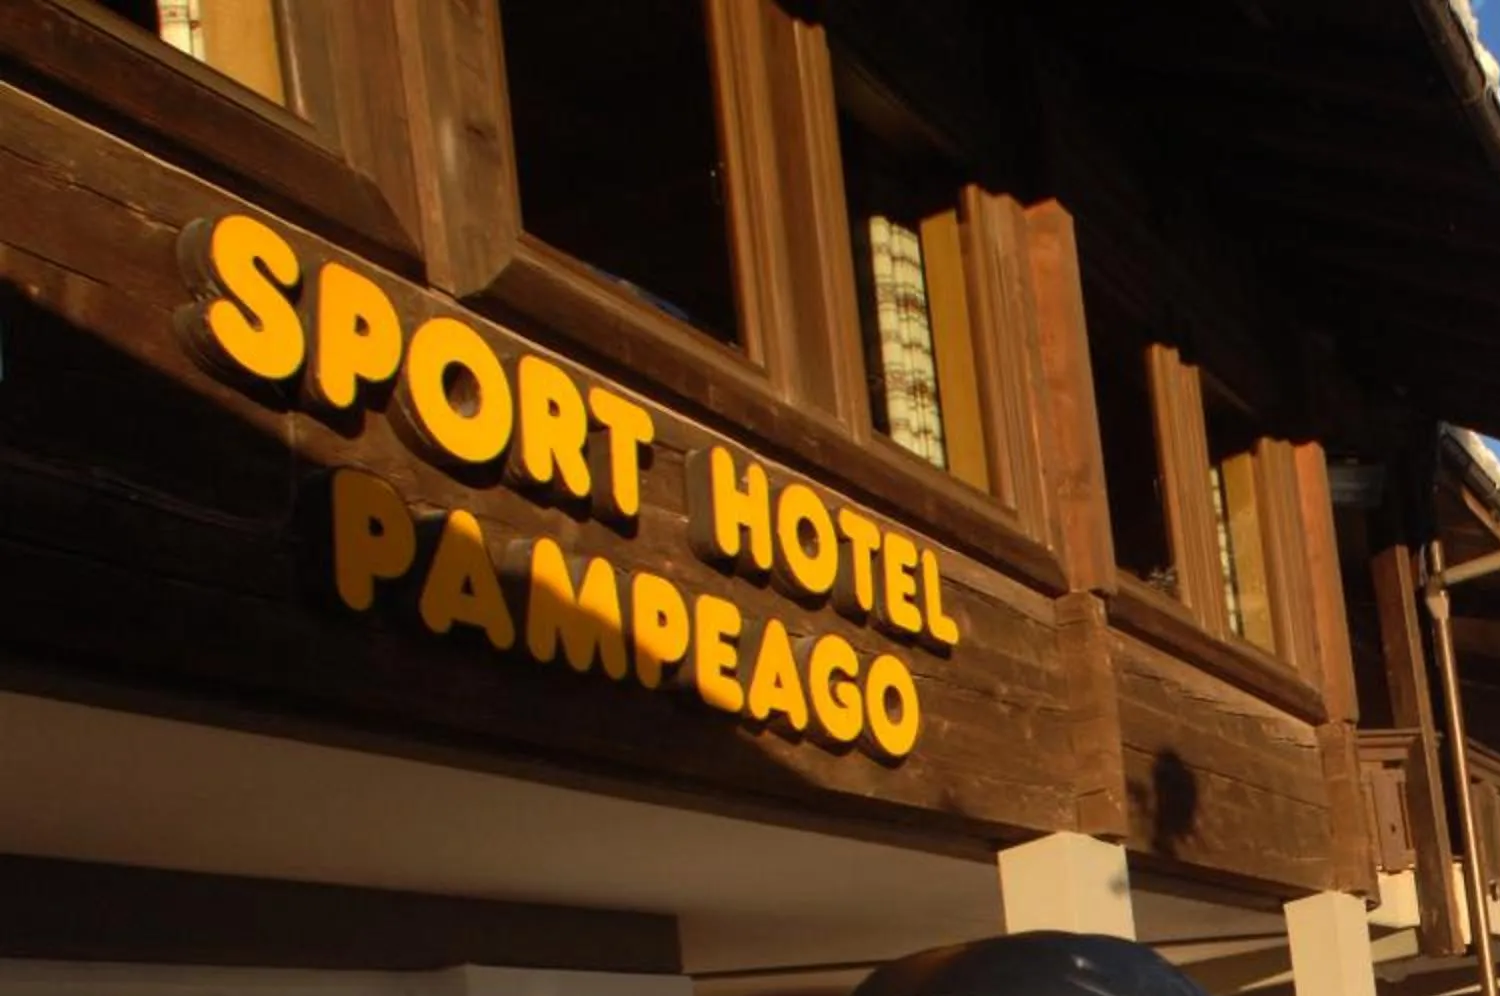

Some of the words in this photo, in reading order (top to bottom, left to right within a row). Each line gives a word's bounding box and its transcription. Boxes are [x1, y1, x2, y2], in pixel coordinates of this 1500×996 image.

[200, 214, 655, 517] SPORT
[709, 446, 960, 646] HOTEL
[330, 468, 920, 758] PAMPEAGO
